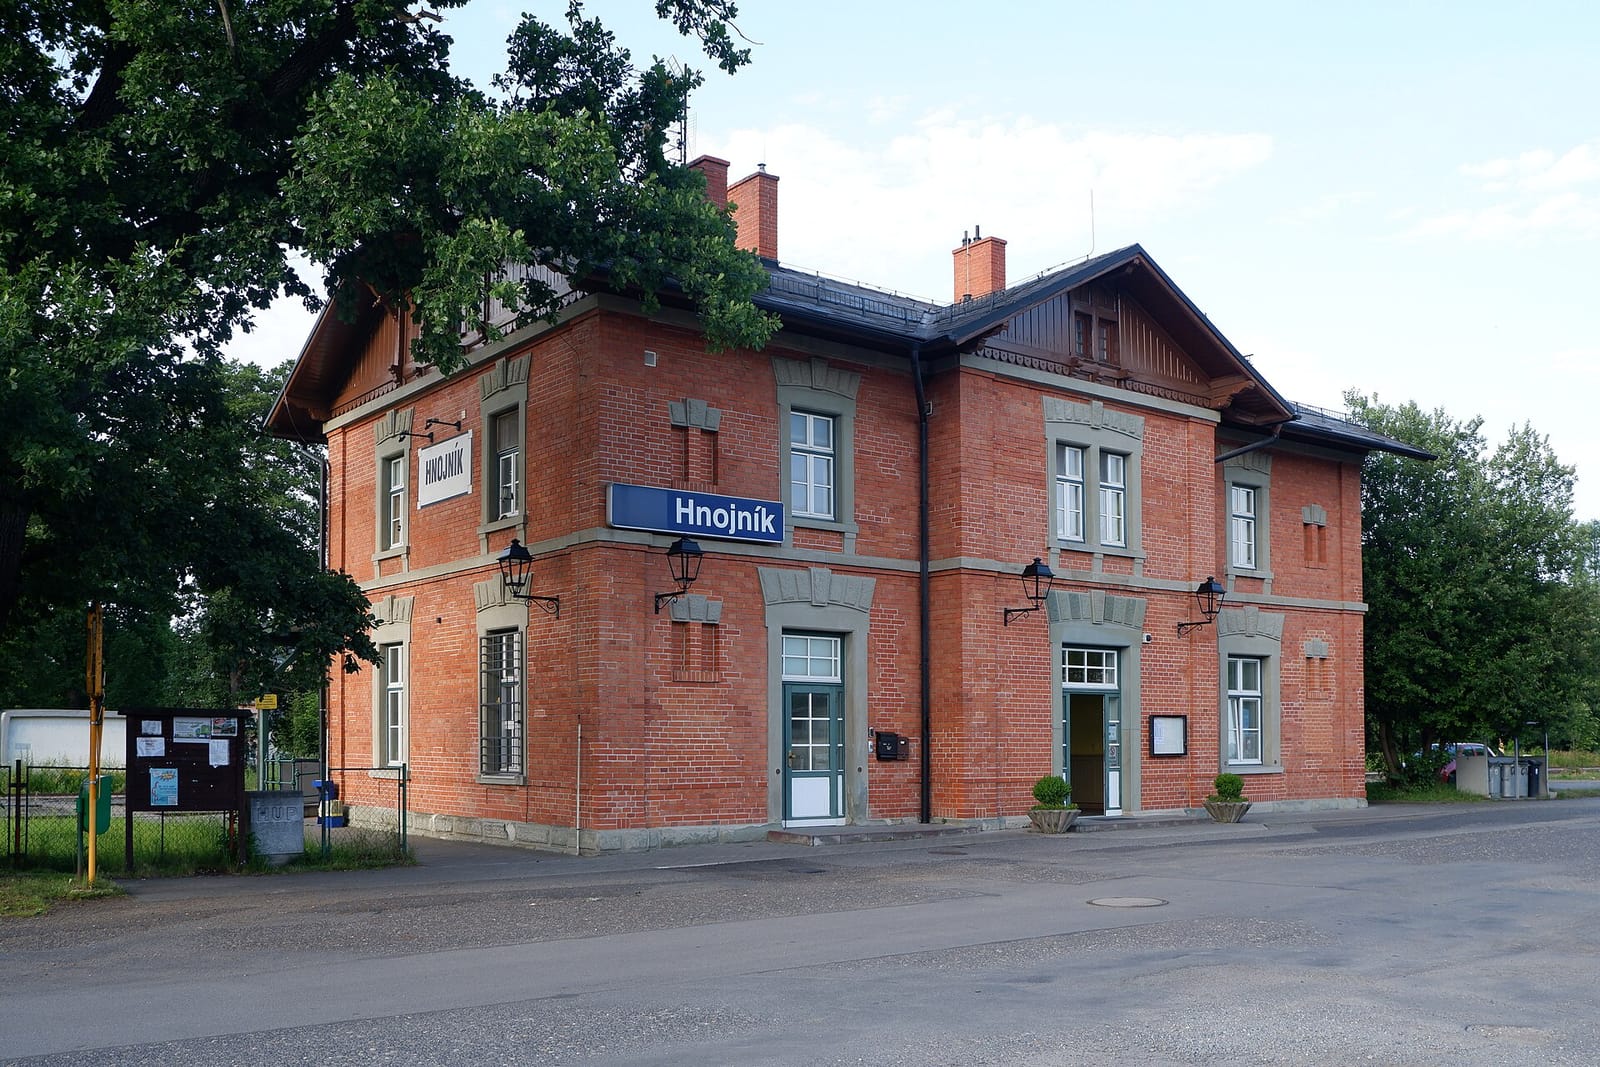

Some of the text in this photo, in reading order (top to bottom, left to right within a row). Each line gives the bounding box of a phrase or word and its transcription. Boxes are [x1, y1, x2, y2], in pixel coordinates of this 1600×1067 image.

[425, 442, 463, 485] HNOJNÍK
[675, 497, 775, 535] Hnojník
[257, 806, 297, 822] HUP
